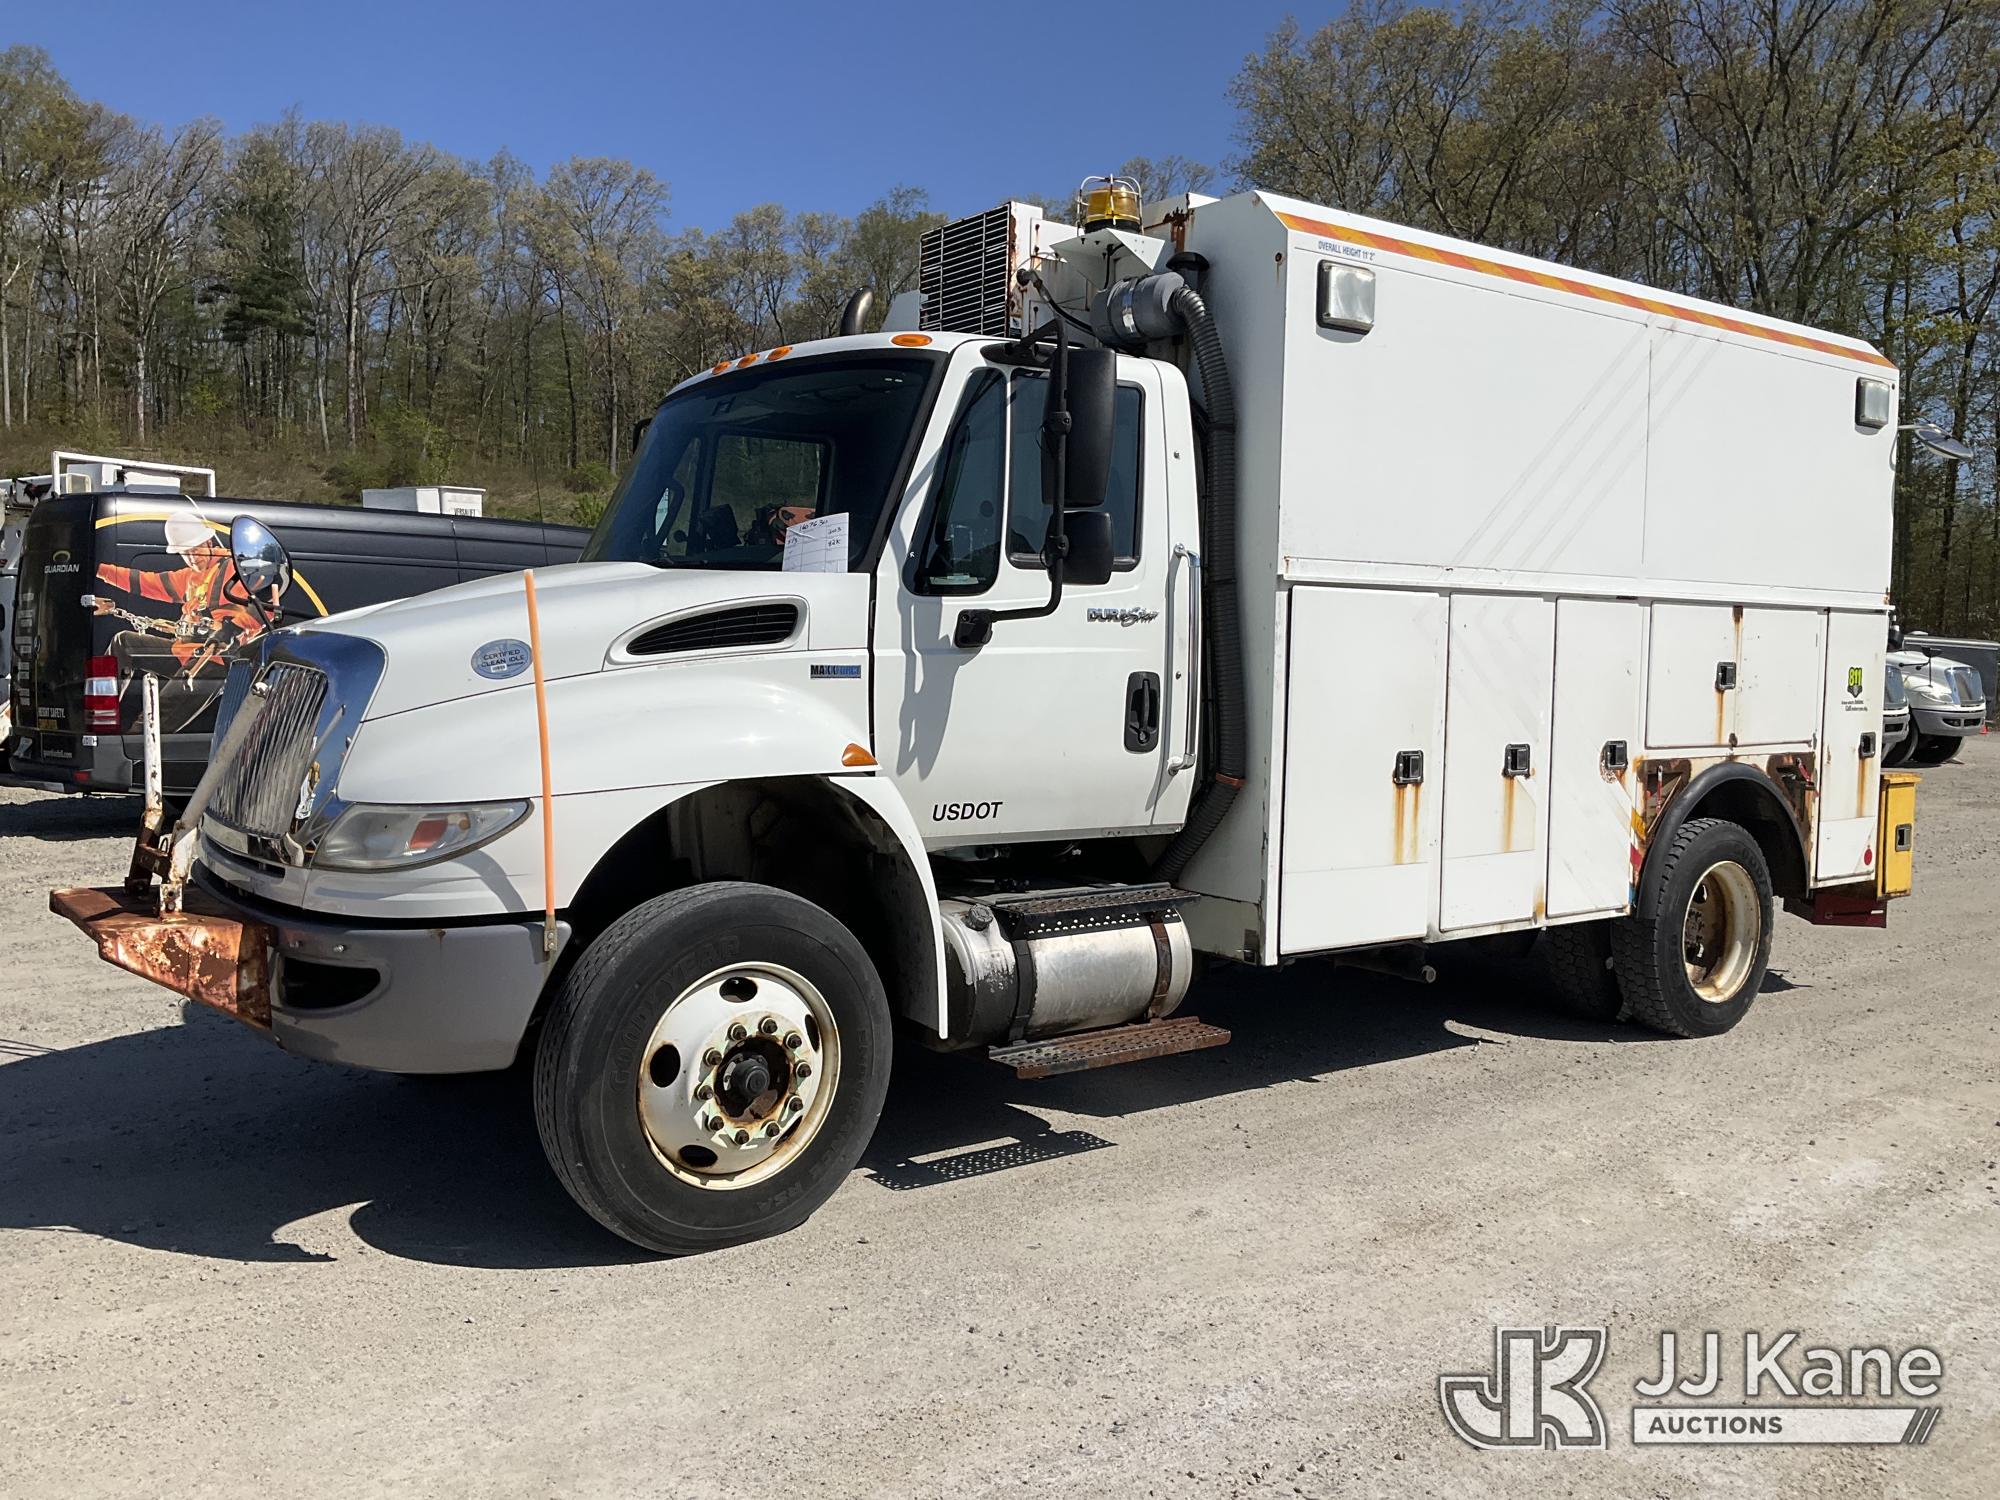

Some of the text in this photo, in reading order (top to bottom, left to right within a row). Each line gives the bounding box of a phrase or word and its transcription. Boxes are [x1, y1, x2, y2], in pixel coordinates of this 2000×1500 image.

[1318, 240, 1342, 254] OVERALL
[1343, 246, 1361, 258] HEIGHT
[44, 564, 80, 574] GUARDIAN
[481, 657, 507, 668] CLEAN
[508, 655, 525, 663] IDLE
[483, 648, 521, 661] CERTIFIED
[1848, 667, 1863, 687] 811
[932, 801, 1004, 821] USDOT
